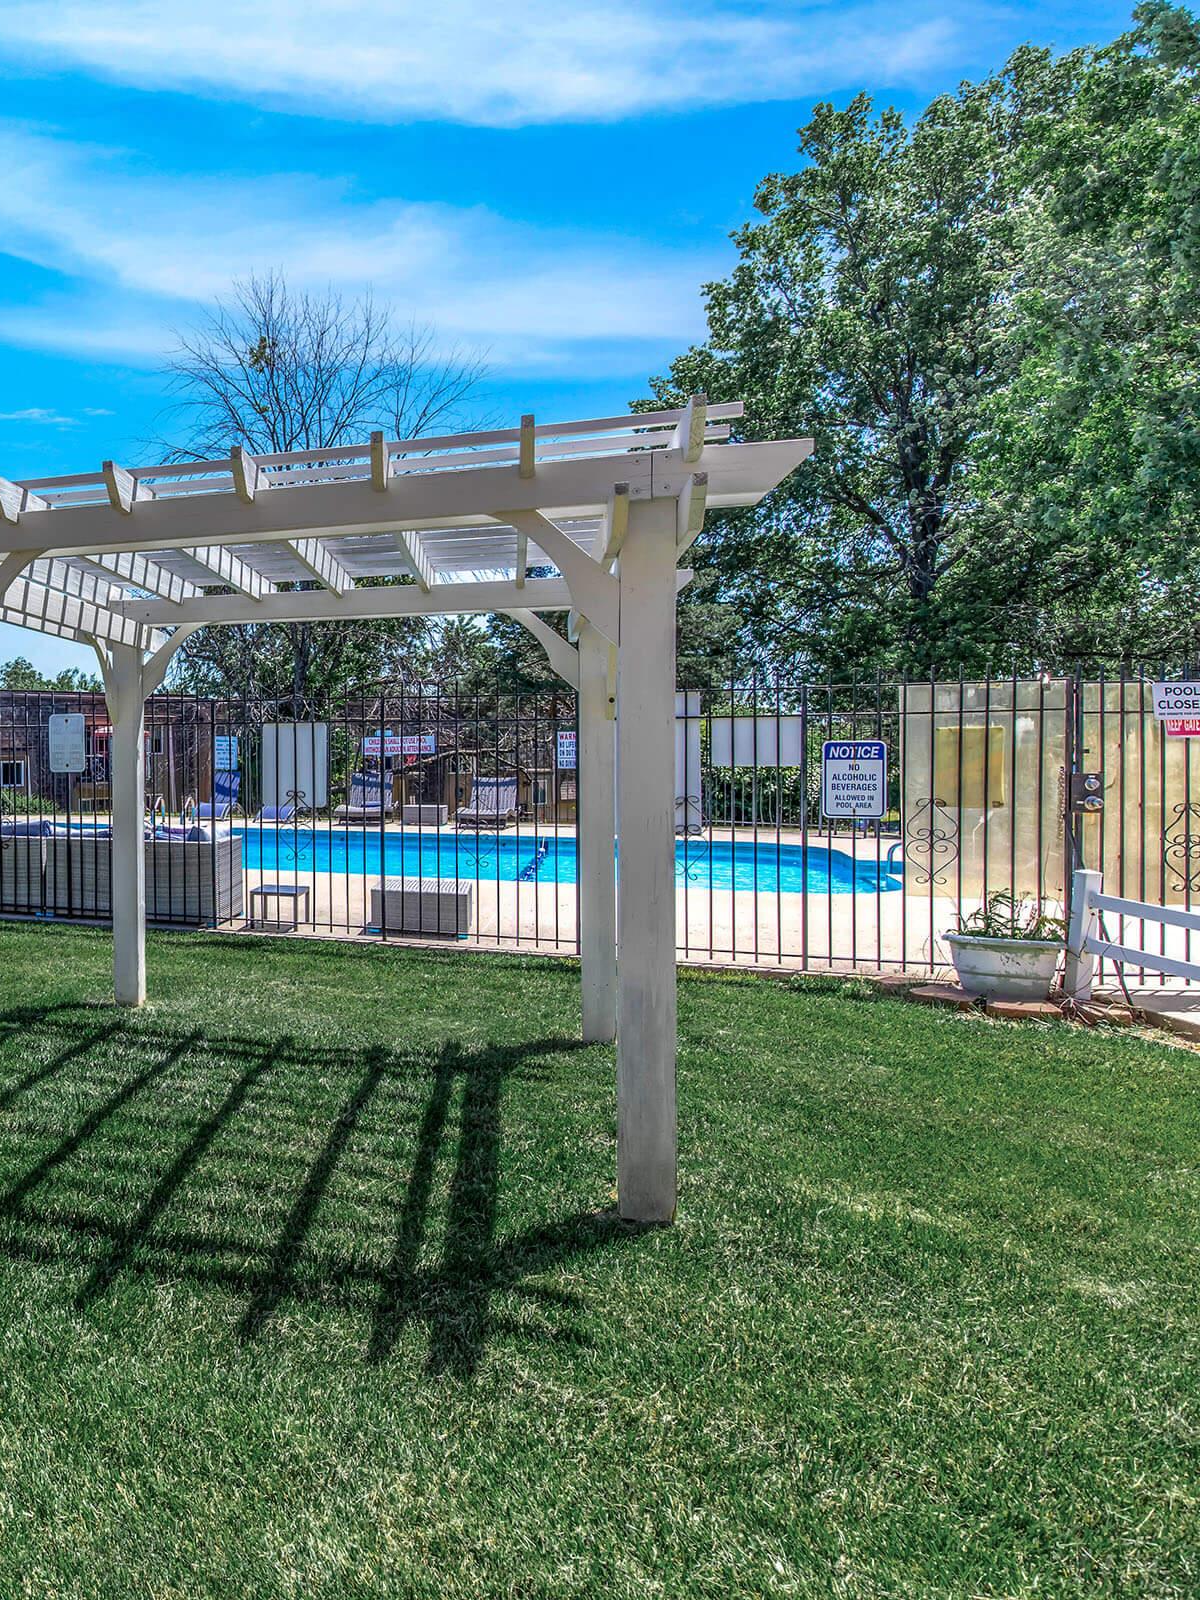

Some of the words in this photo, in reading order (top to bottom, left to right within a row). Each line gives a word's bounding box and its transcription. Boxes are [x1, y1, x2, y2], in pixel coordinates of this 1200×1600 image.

[1165, 687, 1200, 696] POOL
[1158, 699, 1200, 710] CLOSE
[829, 746, 880, 758] NOTICE
[848, 763, 860, 771] NO
[832, 773, 877, 781] ALCOHOLIC
[831, 783, 878, 791] BEVERAGES
